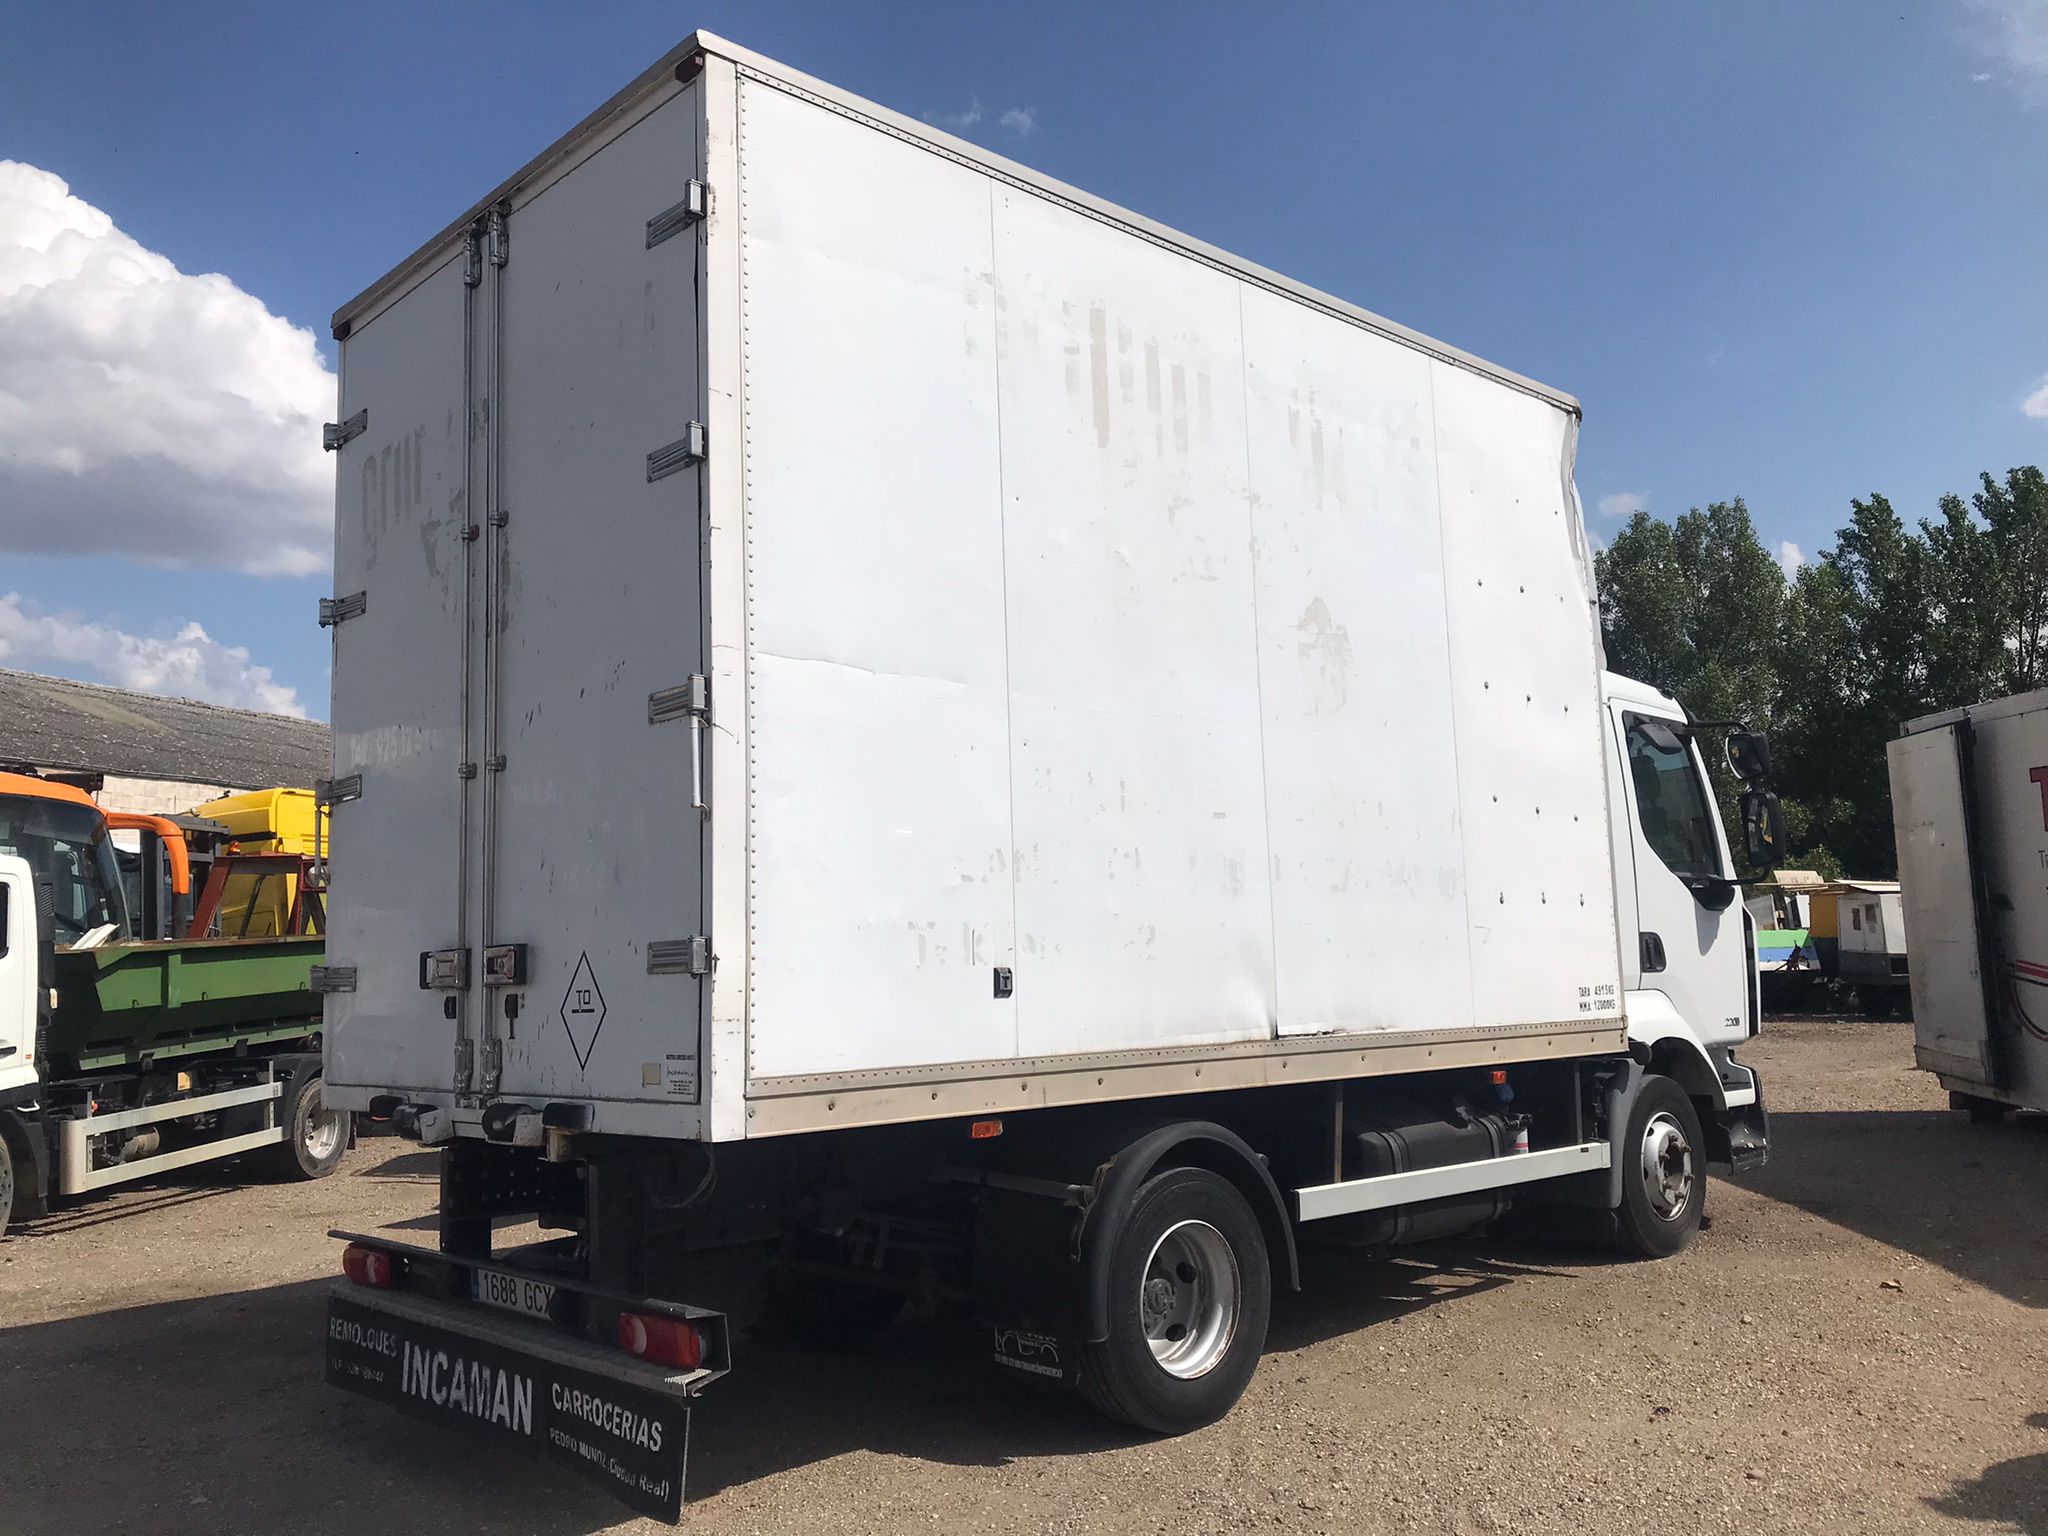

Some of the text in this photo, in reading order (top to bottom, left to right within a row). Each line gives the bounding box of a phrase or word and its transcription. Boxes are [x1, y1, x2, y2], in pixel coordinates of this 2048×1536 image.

[576, 989, 591, 1006] TO
[1579, 986, 1590, 998] TARA
[484, 1272, 517, 1306] 1688
[329, 1316, 397, 1358] REMOLQUES
[401, 1340, 533, 1436] INCAMAN
[551, 1382, 663, 1453] CARROCERIAS
[549, 1427, 577, 1452] PEDRO
[638, 1476, 670, 1503] Real)
